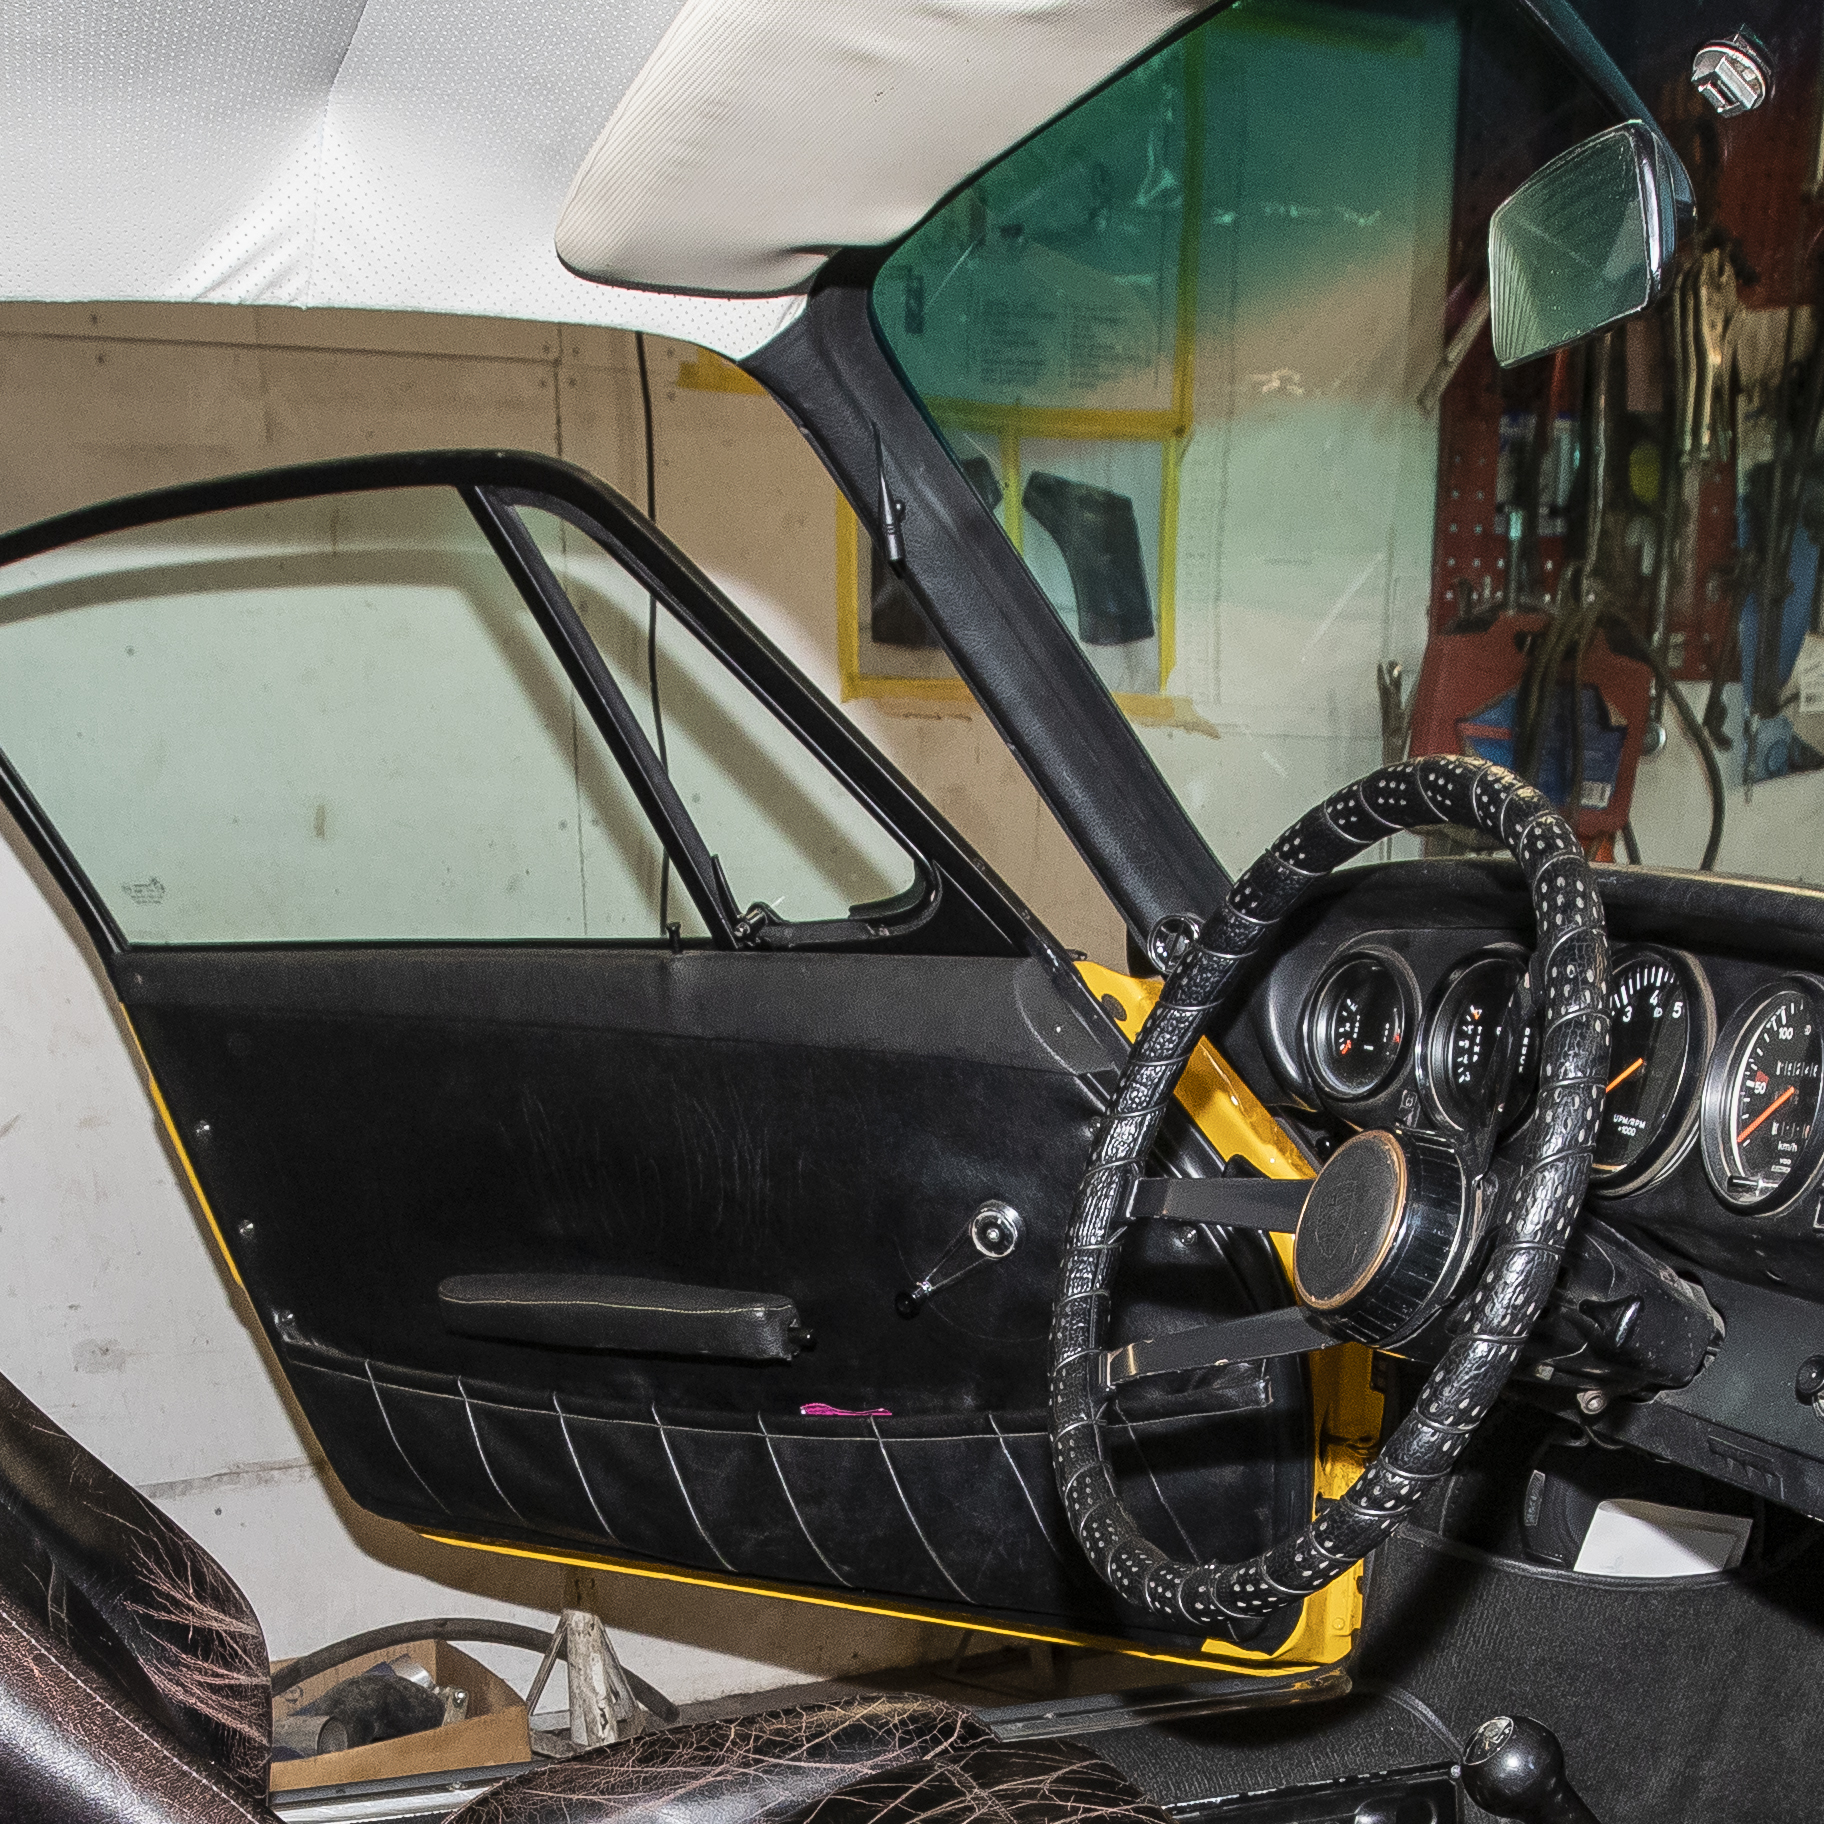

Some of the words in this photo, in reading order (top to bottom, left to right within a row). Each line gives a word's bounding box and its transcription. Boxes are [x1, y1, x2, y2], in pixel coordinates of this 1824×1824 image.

[1622, 1005, 1634, 1023] 3
[1649, 989, 1660, 1006] 4
[1671, 1001, 1684, 1019] 5
[1778, 1026, 1794, 1040] 100
[1753, 1082, 1767, 1095] 50
[1777, 1141, 1798, 1152] km/h
